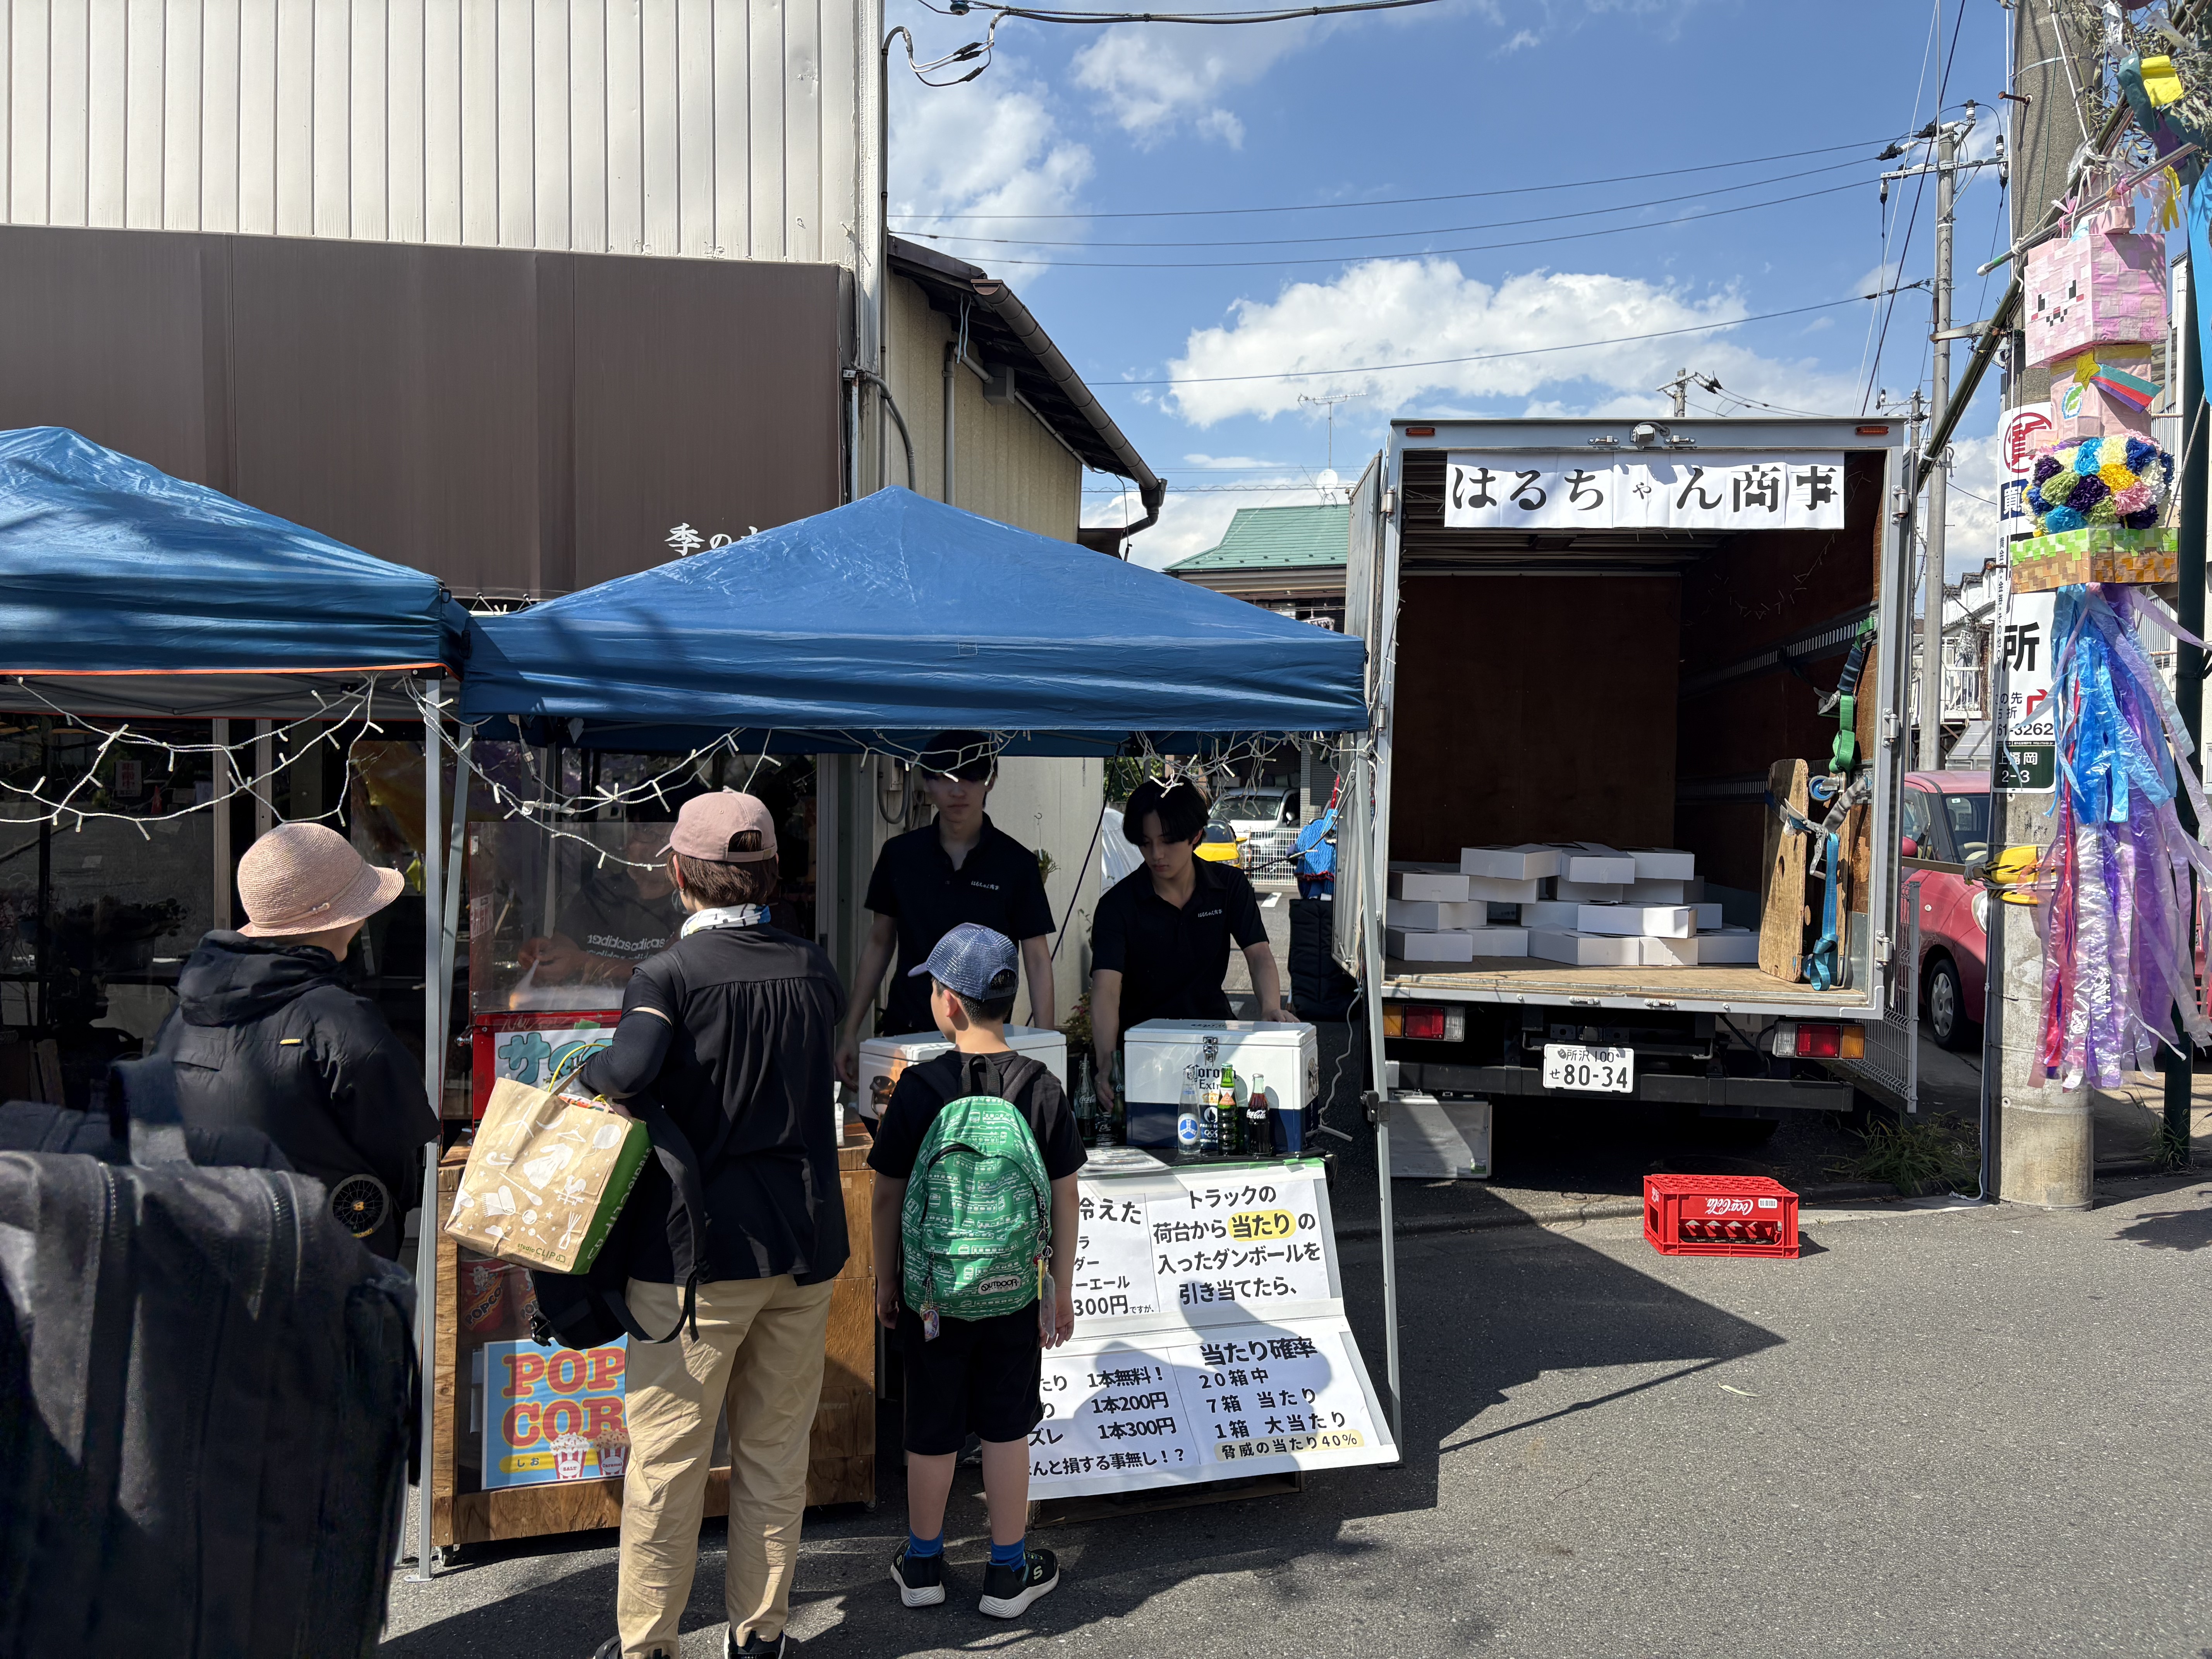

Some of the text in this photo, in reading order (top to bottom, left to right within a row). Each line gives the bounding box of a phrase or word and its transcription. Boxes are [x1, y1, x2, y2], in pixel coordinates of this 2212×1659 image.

[1452, 464, 1839, 512] はるちゃん商事
[665, 523, 758, 556] 季の
[1997, 723, 2054, 736] 61-3262
[2002, 770, 2030, 783] 2-3
[1549, 1064, 1628, 1089] せ 80-34
[1190, 1185, 1276, 1209] トラックの
[517, 1243, 556, 1258] studio CLIP
[1158, 1242, 1321, 1275] 入ったダンボールを
[1074, 1256, 1099, 1271] ダー
[981, 1279, 1017, 1291] OUTDOOR
[1075, 1276, 1130, 1290] ーエール
[1179, 1276, 1297, 1305] 引き当てたら、
[1200, 1336, 1318, 1365] 当たり確率
[502, 1347, 625, 1396] POP
[1199, 1367, 1269, 1389] 20箱中
[1091, 1391, 1169, 1414] 1本200円
[1206, 1388, 1316, 1413] 7箱 当たり
[501, 1396, 627, 1449] COR
[1029, 1417, 1176, 1446] ズレ 1本300円
[1215, 1412, 1345, 1439] 1箱 大当たり
[517, 1457, 539, 1468] しお
[1029, 1448, 1184, 1476] んと損する事無し！？
